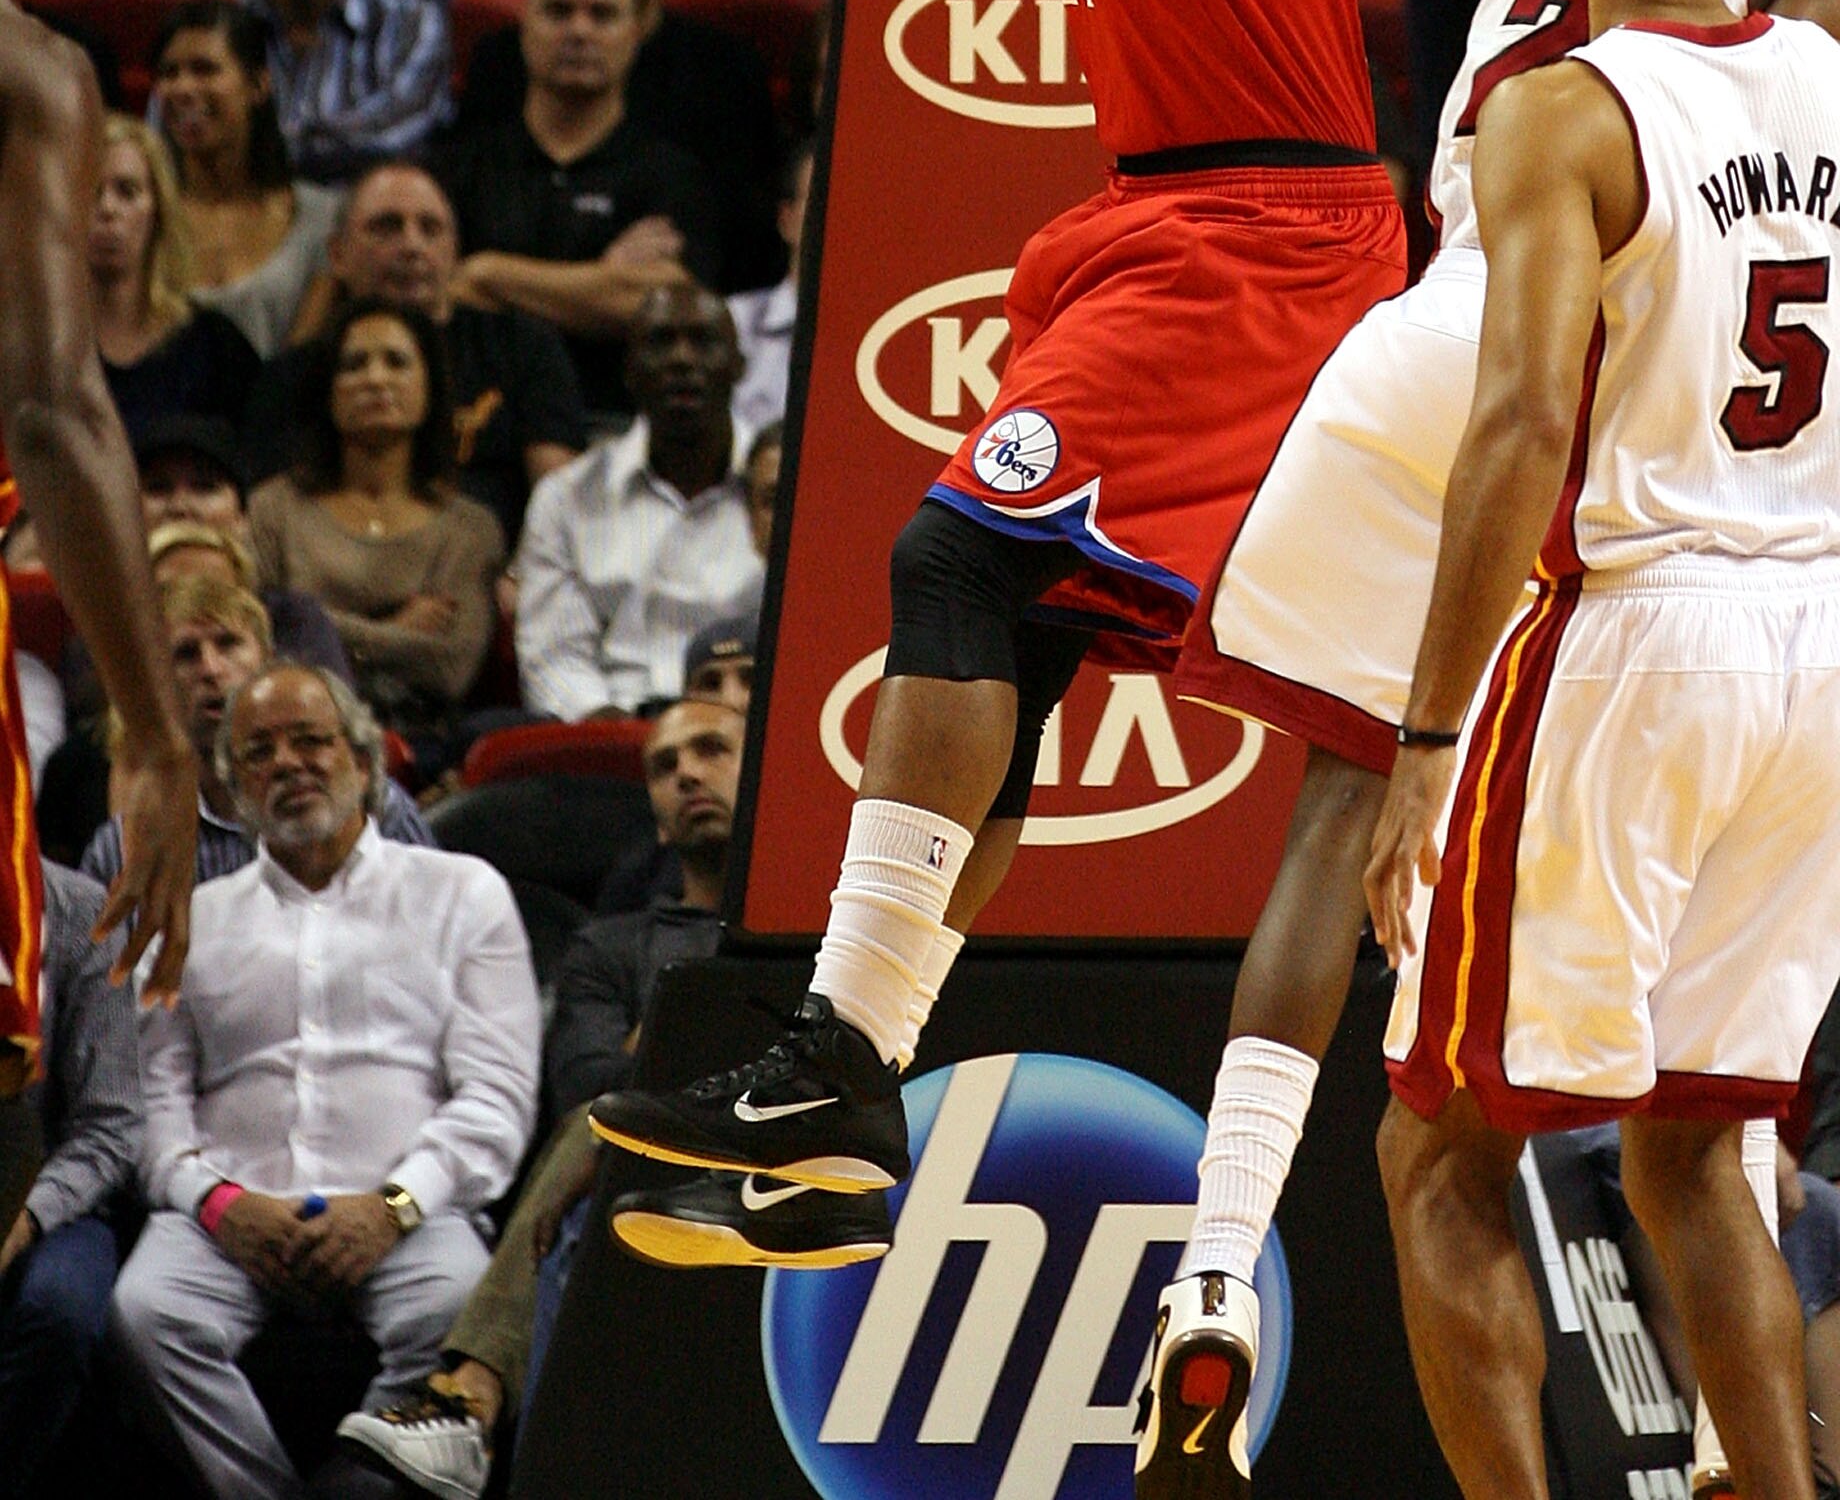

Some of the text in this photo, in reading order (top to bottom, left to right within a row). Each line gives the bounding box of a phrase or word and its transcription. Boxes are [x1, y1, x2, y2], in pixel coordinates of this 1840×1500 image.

[1719, 255, 1830, 452] 5
[980, 433, 1037, 481] 76ers
[1033, 674, 1191, 787] IA
